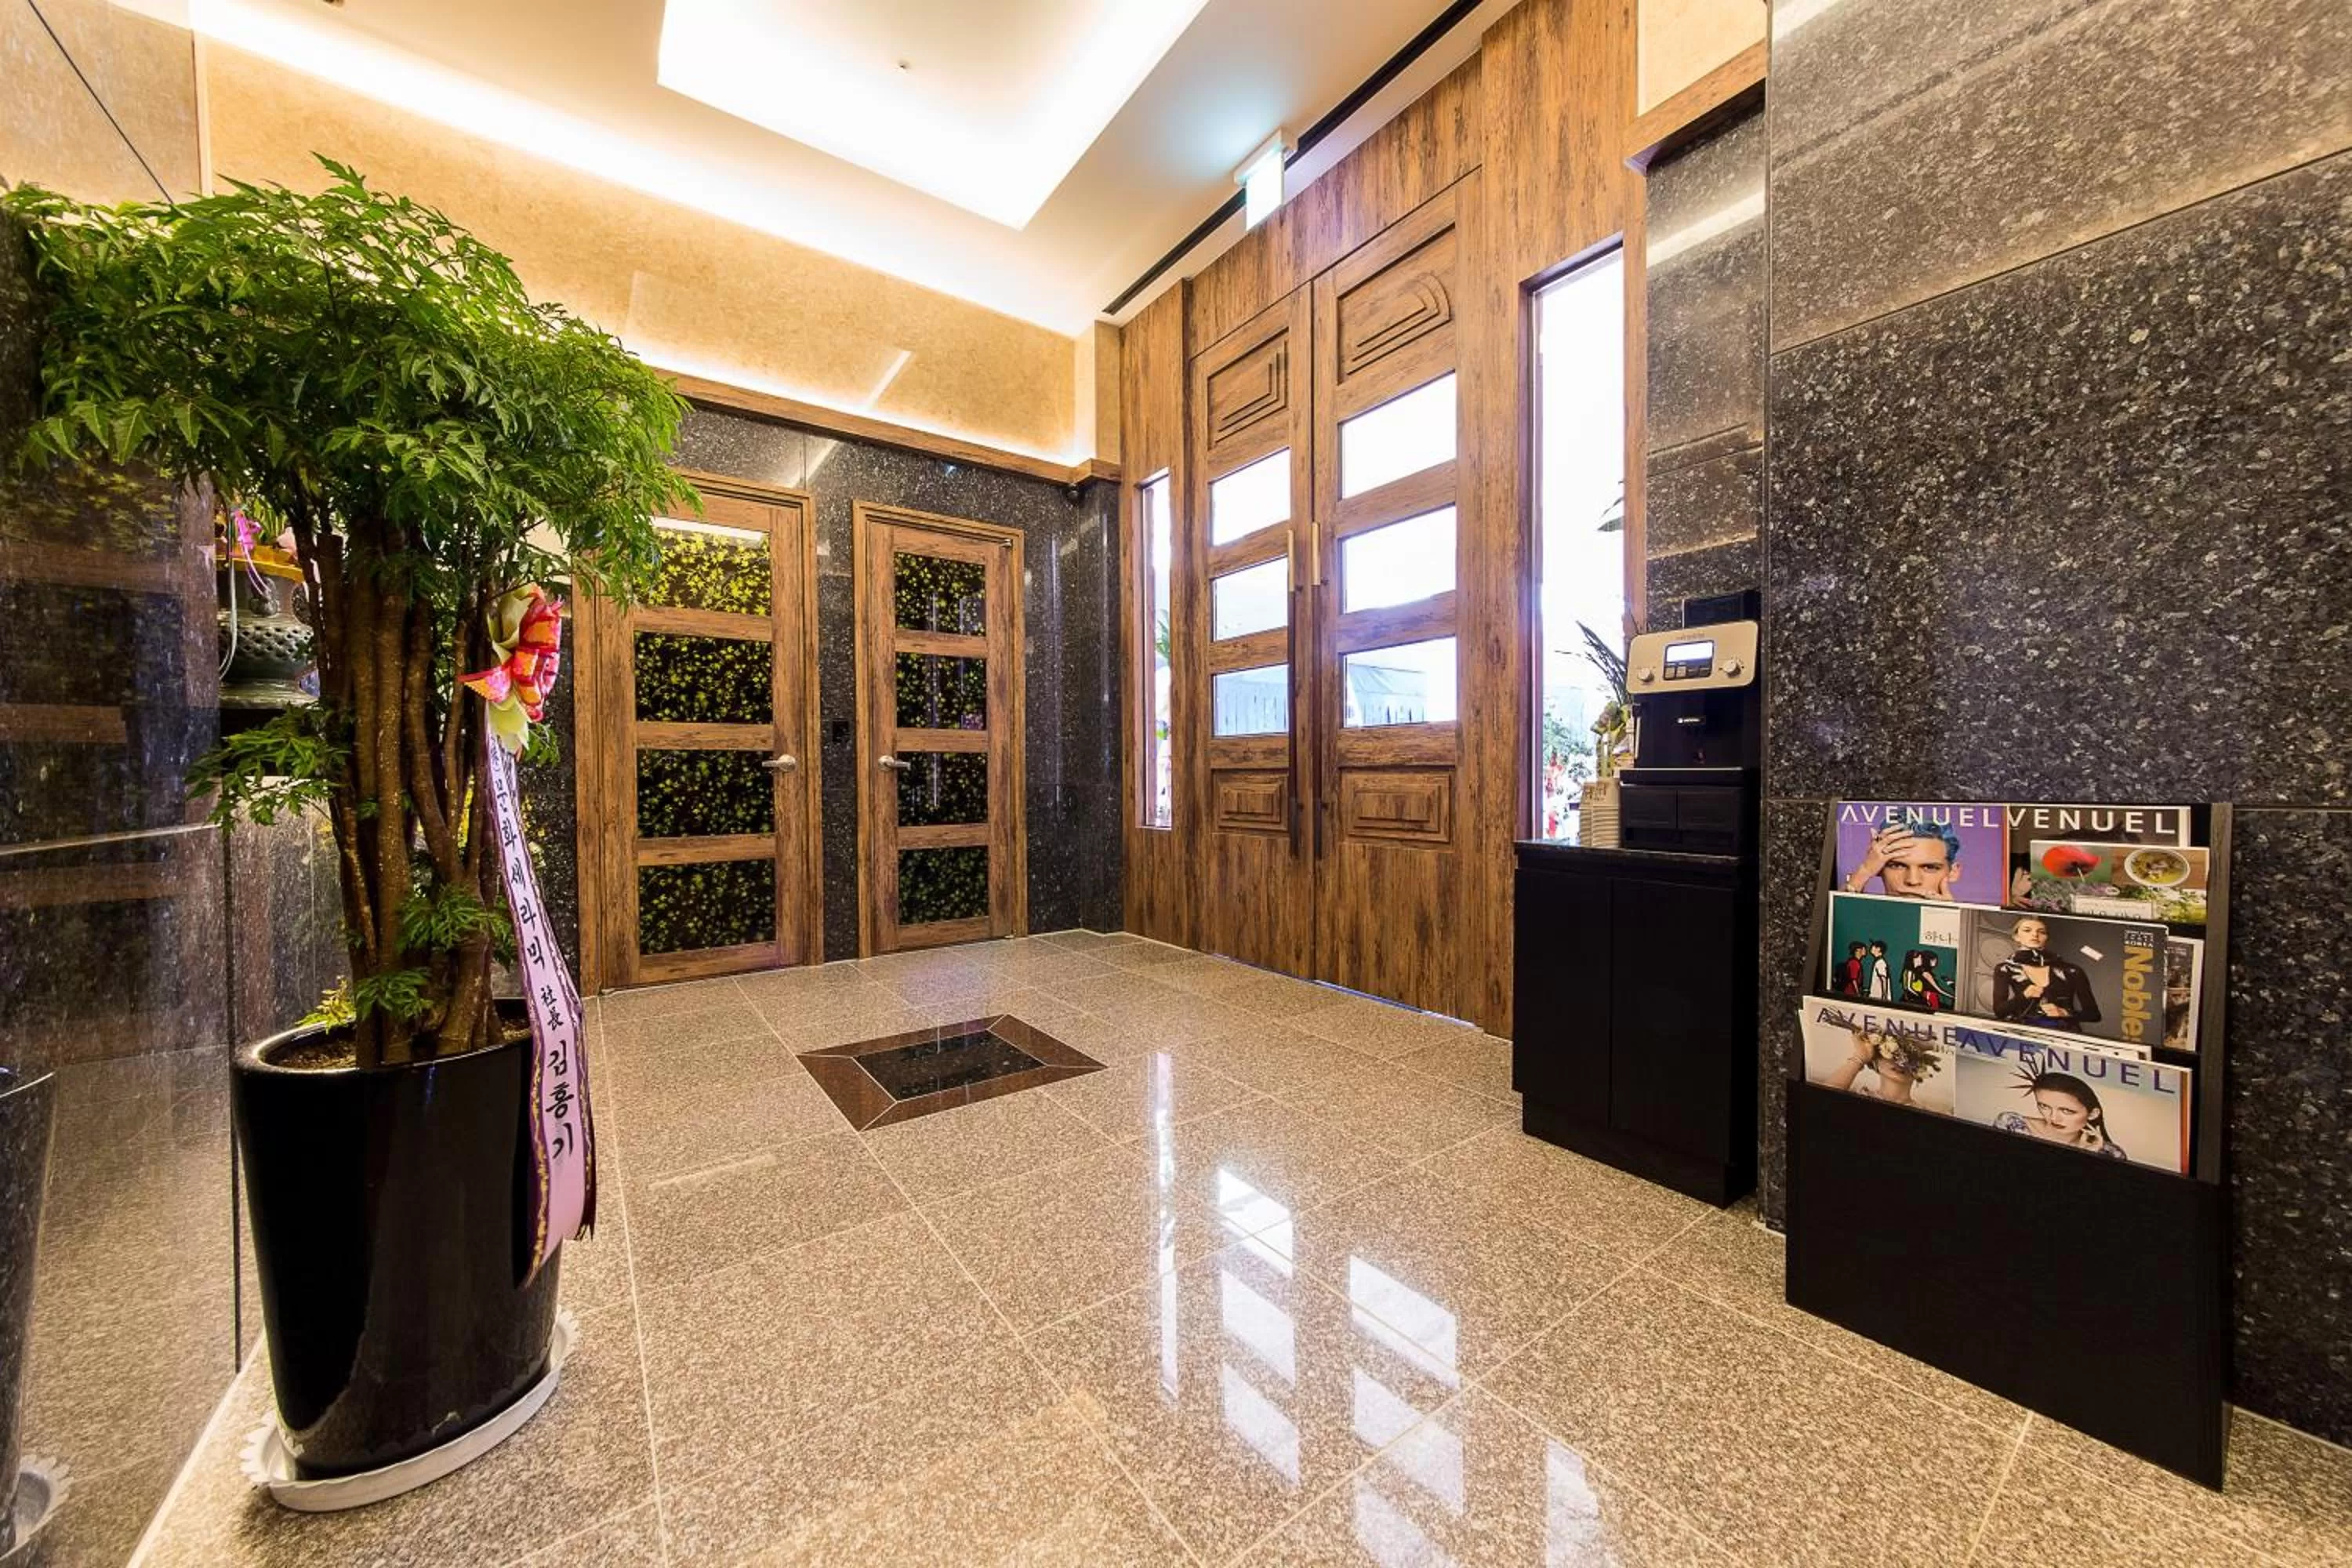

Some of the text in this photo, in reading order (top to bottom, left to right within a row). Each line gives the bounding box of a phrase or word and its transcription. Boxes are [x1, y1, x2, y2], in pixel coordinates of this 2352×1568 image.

[1842, 804, 2000, 828] AVENUEL
[2121, 946, 2154, 1042] Noble
[545, 1039, 575, 1160] 김홍기
[1960, 1030, 2175, 1094] AVENUEL
